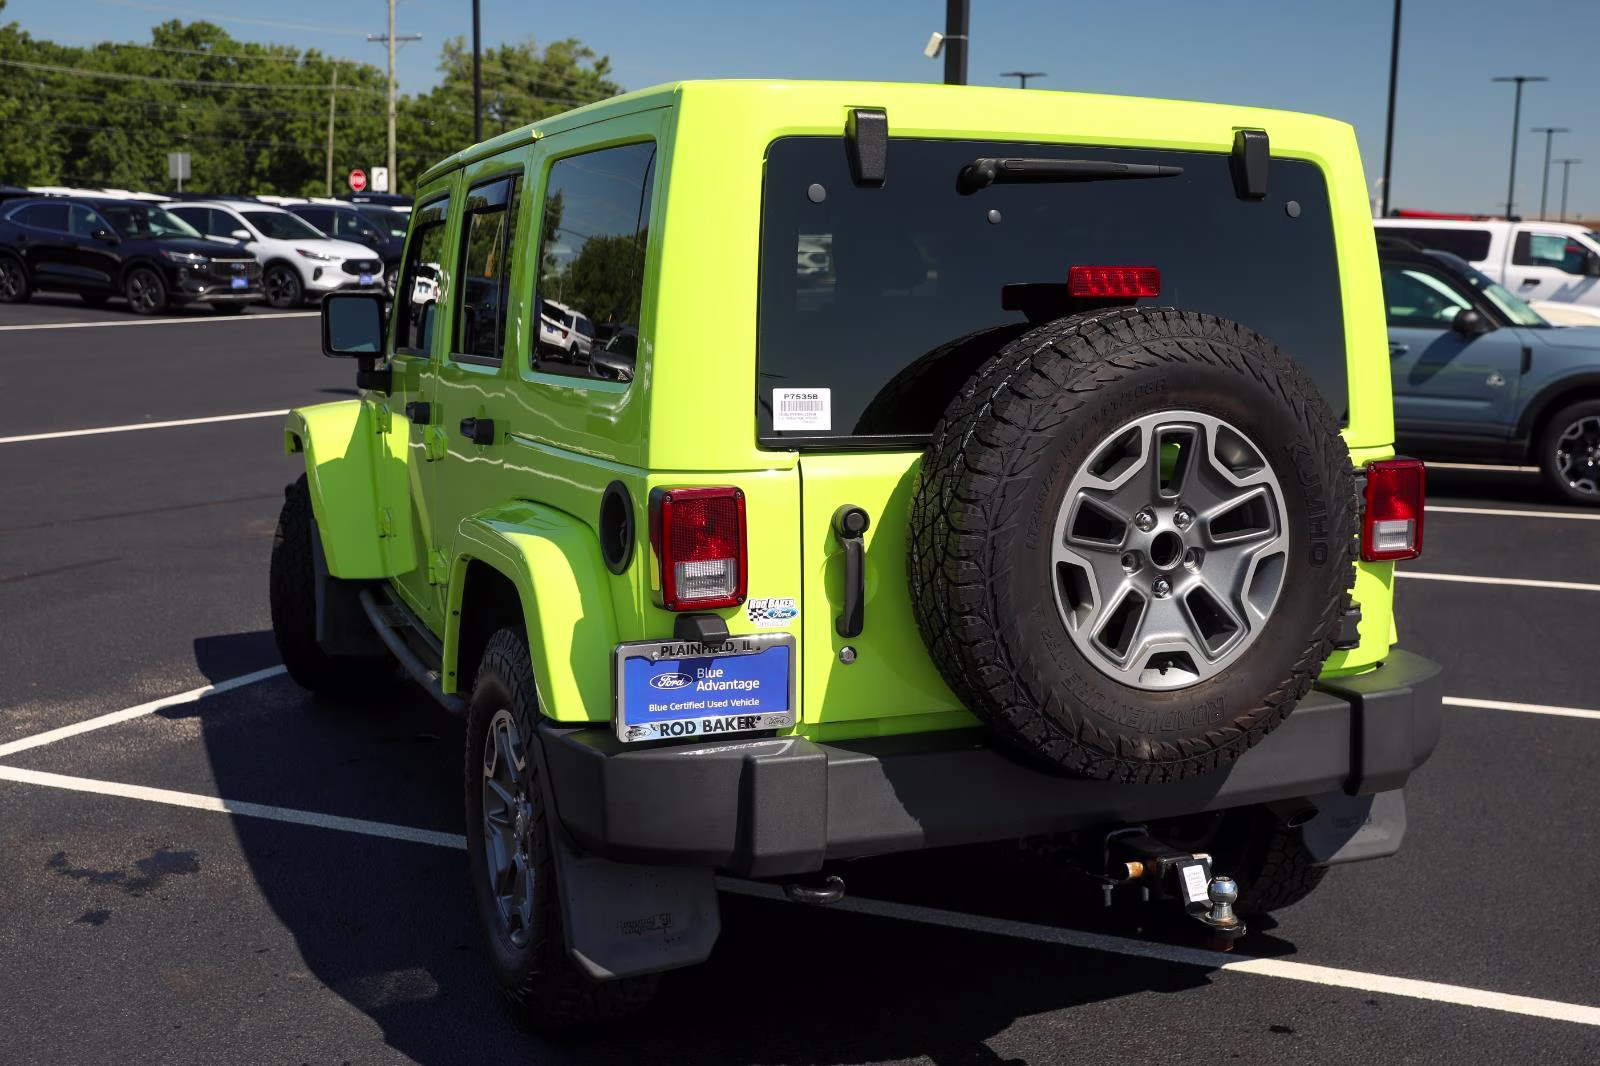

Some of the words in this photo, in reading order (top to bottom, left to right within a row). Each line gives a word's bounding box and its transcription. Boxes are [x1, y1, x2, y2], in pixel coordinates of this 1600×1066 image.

[697, 668, 724, 679] Blue
[657, 674, 685, 688] Ford
[696, 679, 760, 692] Advantage
[648, 704, 668, 712] Blue
[669, 700, 705, 711] Certified
[707, 699, 728, 708] Used
[730, 697, 760, 707] Vehicle
[660, 720, 697, 737] ROD
[703, 715, 756, 733] BAKER
